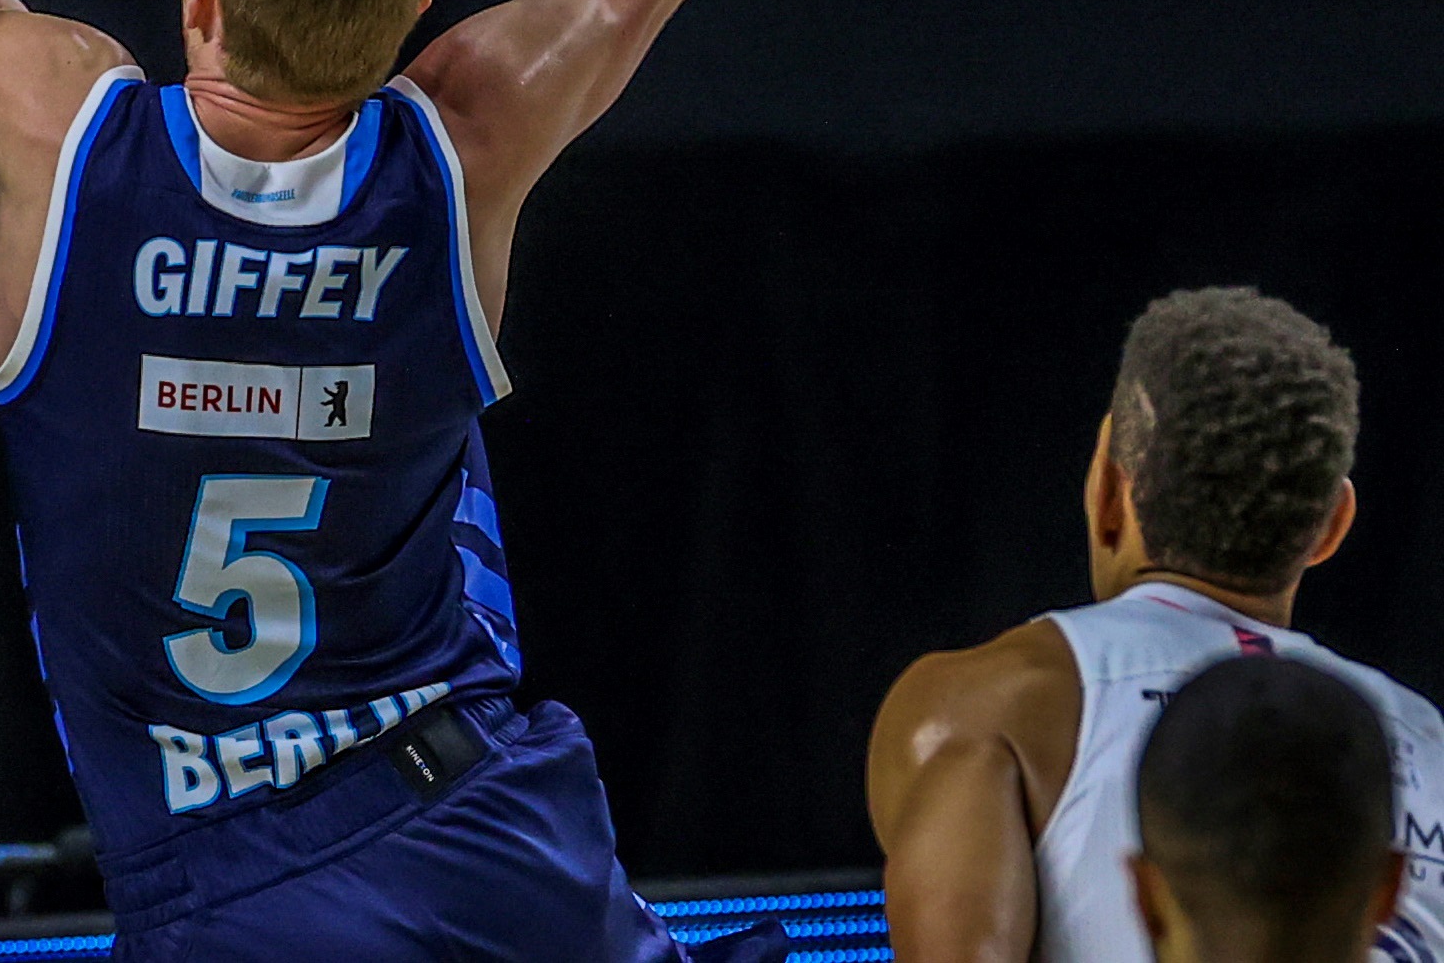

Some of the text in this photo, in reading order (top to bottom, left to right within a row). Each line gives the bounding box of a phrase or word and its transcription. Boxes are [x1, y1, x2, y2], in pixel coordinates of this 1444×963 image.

[133, 237, 409, 322] GIFFEY
[157, 380, 283, 414] BERLIN
[162, 473, 332, 705] 5
